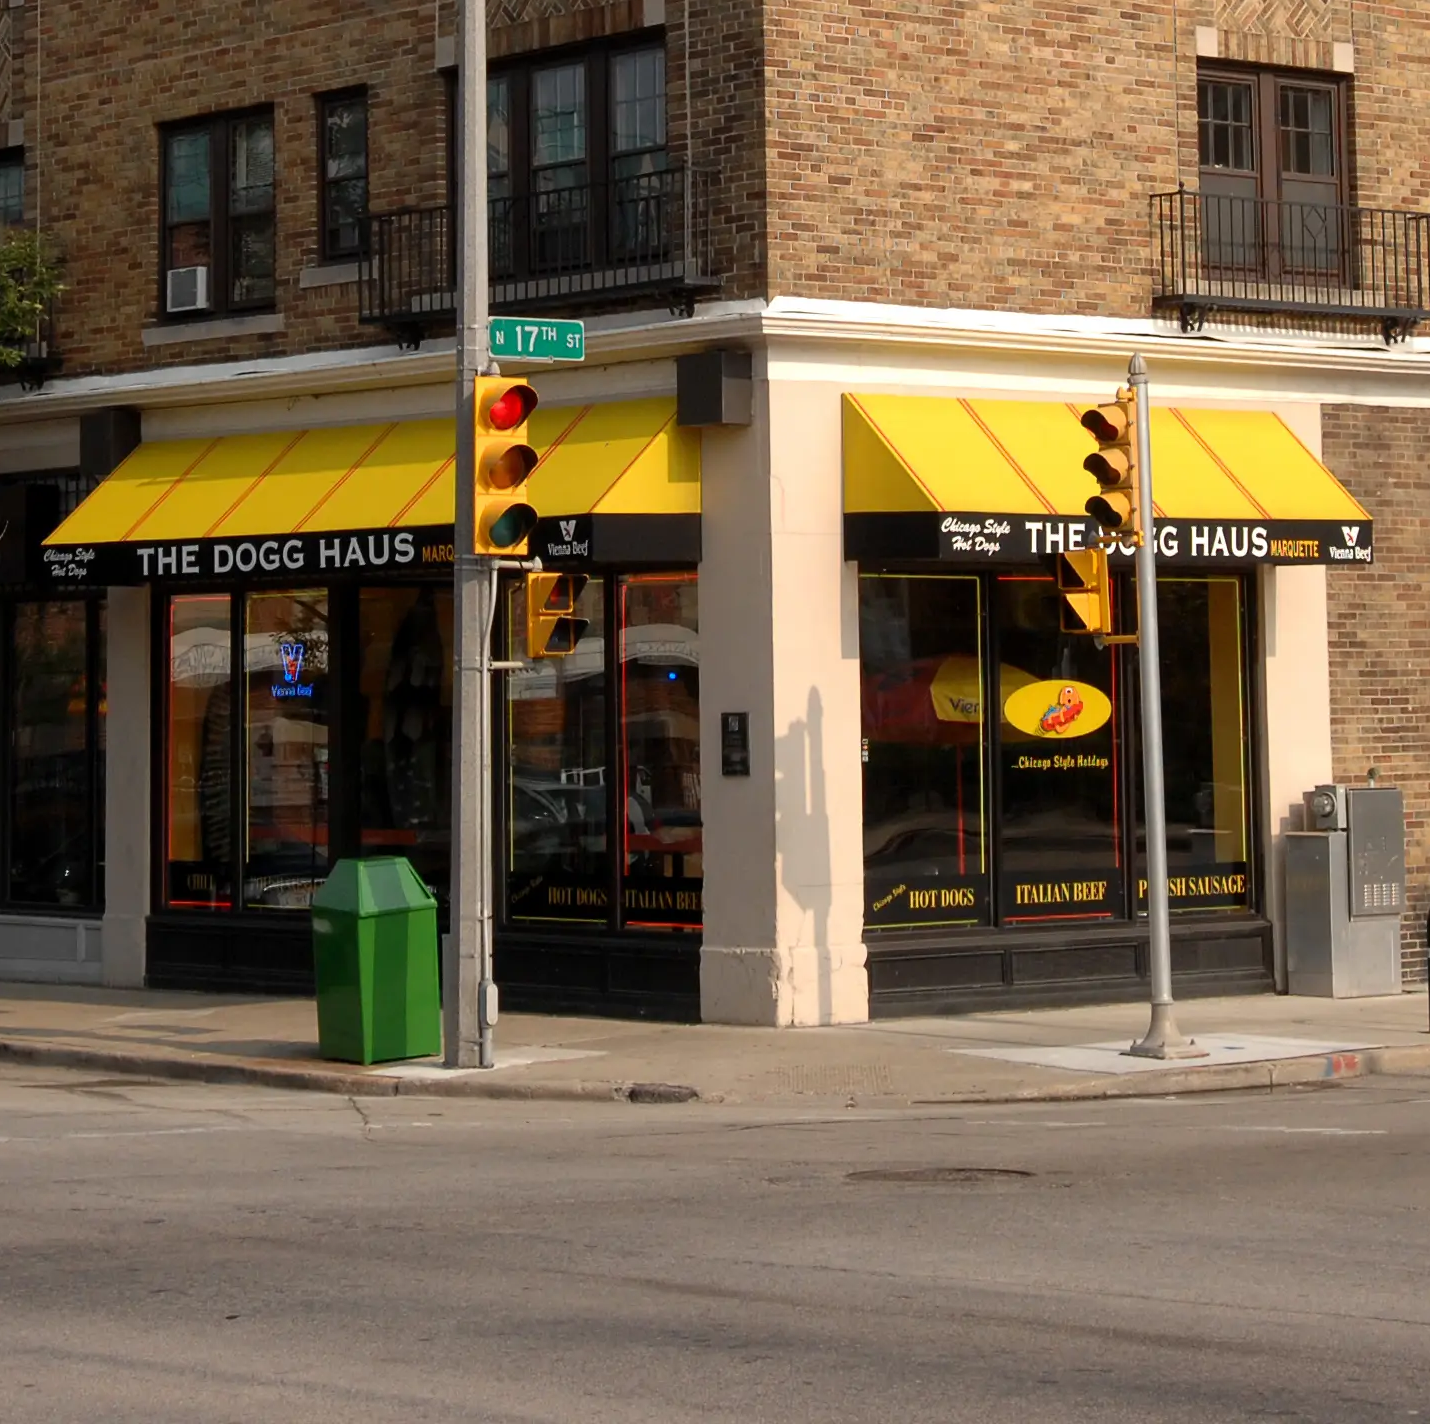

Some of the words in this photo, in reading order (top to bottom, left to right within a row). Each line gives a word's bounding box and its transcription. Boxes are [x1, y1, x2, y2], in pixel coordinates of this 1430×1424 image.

[495, 330, 505, 345] N
[515, 325, 557, 352] 17TH
[565, 333, 581, 349] ST
[941, 517, 982, 537] Chicago
[983, 519, 1011, 537] Style
[951, 536, 972, 551] Hot
[974, 537, 1001, 556] Dogs
[1025, 521, 1085, 554] THE
[1190, 526, 1268, 557] HAUS
[1271, 539, 1319, 558] MARQUETTE
[136, 544, 200, 576] THE
[213, 539, 305, 574] DOGG
[319, 532, 415, 569] HAUS
[1329, 546, 1354, 559] Vienna
[1355, 545, 1372, 561] Beef
[1053, 755, 1075, 770] Style
[1015, 883, 1072, 905] ITALIAN
[1073, 881, 1107, 902] BEEF
[1188, 874, 1245, 896] SAUSAGE
[548, 887, 572, 906] HOT
[576, 887, 608, 907] DOGS
[625, 889, 672, 910] ITALIAN
[909, 890, 938, 909] HOT
[941, 888, 975, 907] DOGS
